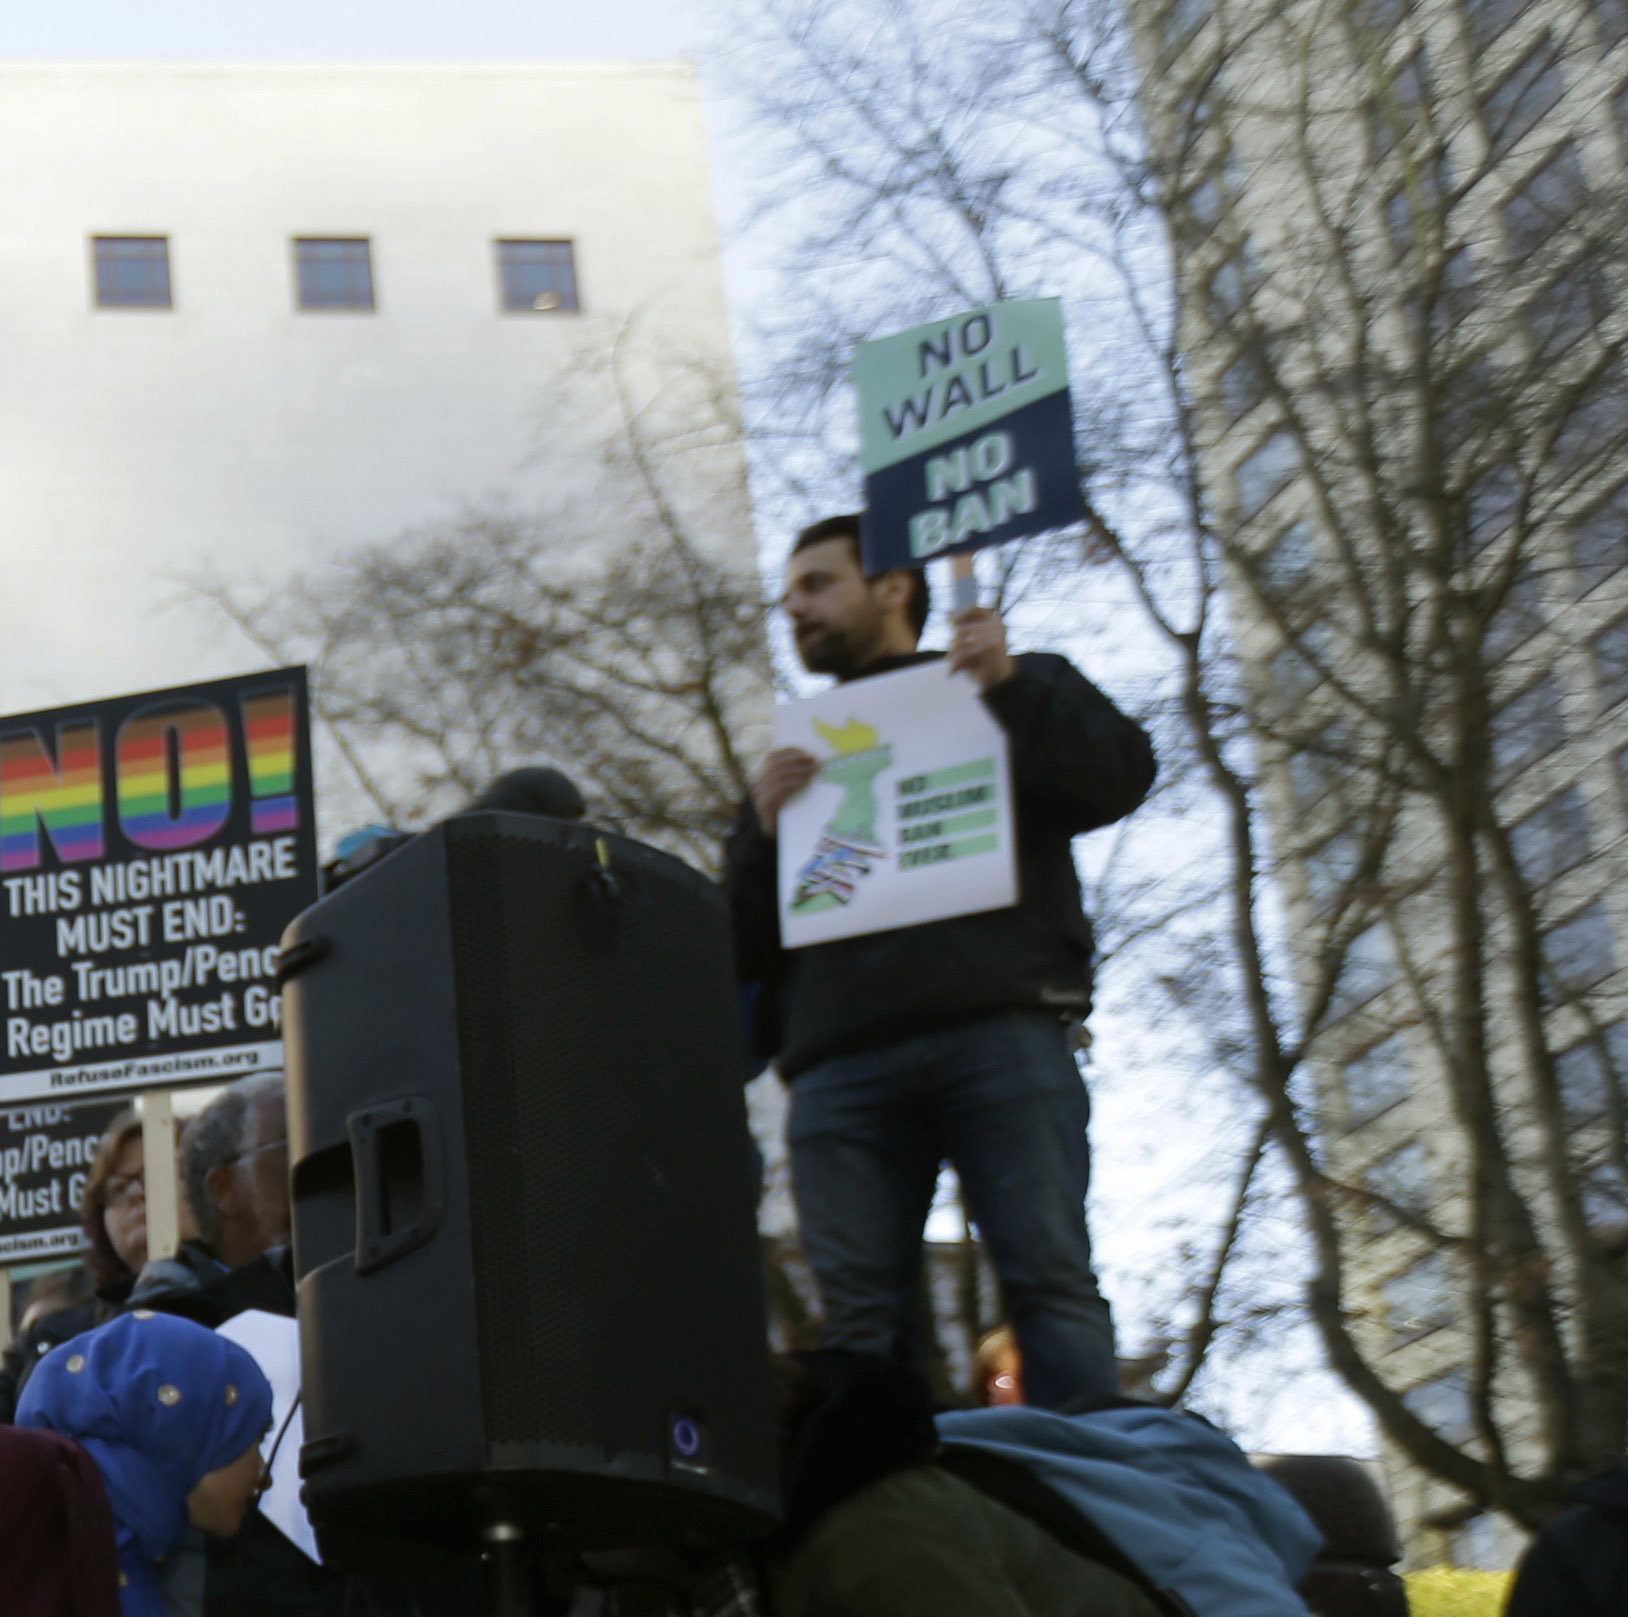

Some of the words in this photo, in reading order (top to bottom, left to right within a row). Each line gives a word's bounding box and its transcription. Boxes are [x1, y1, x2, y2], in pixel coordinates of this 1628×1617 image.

[918, 312, 993, 378] NO
[881, 345, 1043, 440] WALL
[924, 430, 1014, 502] NO
[909, 467, 1037, 559] BAN
[3, 870, 82, 917] THIS
[90, 837, 298, 906] NIGHTMARE
[56, 906, 154, 957] MUST
[162, 894, 246, 943] END:
[1, 969, 65, 1011] The
[72, 945, 282, 1000] Trump/Penc
[7, 1010, 137, 1062] Regime
[147, 992, 237, 1039] Must
